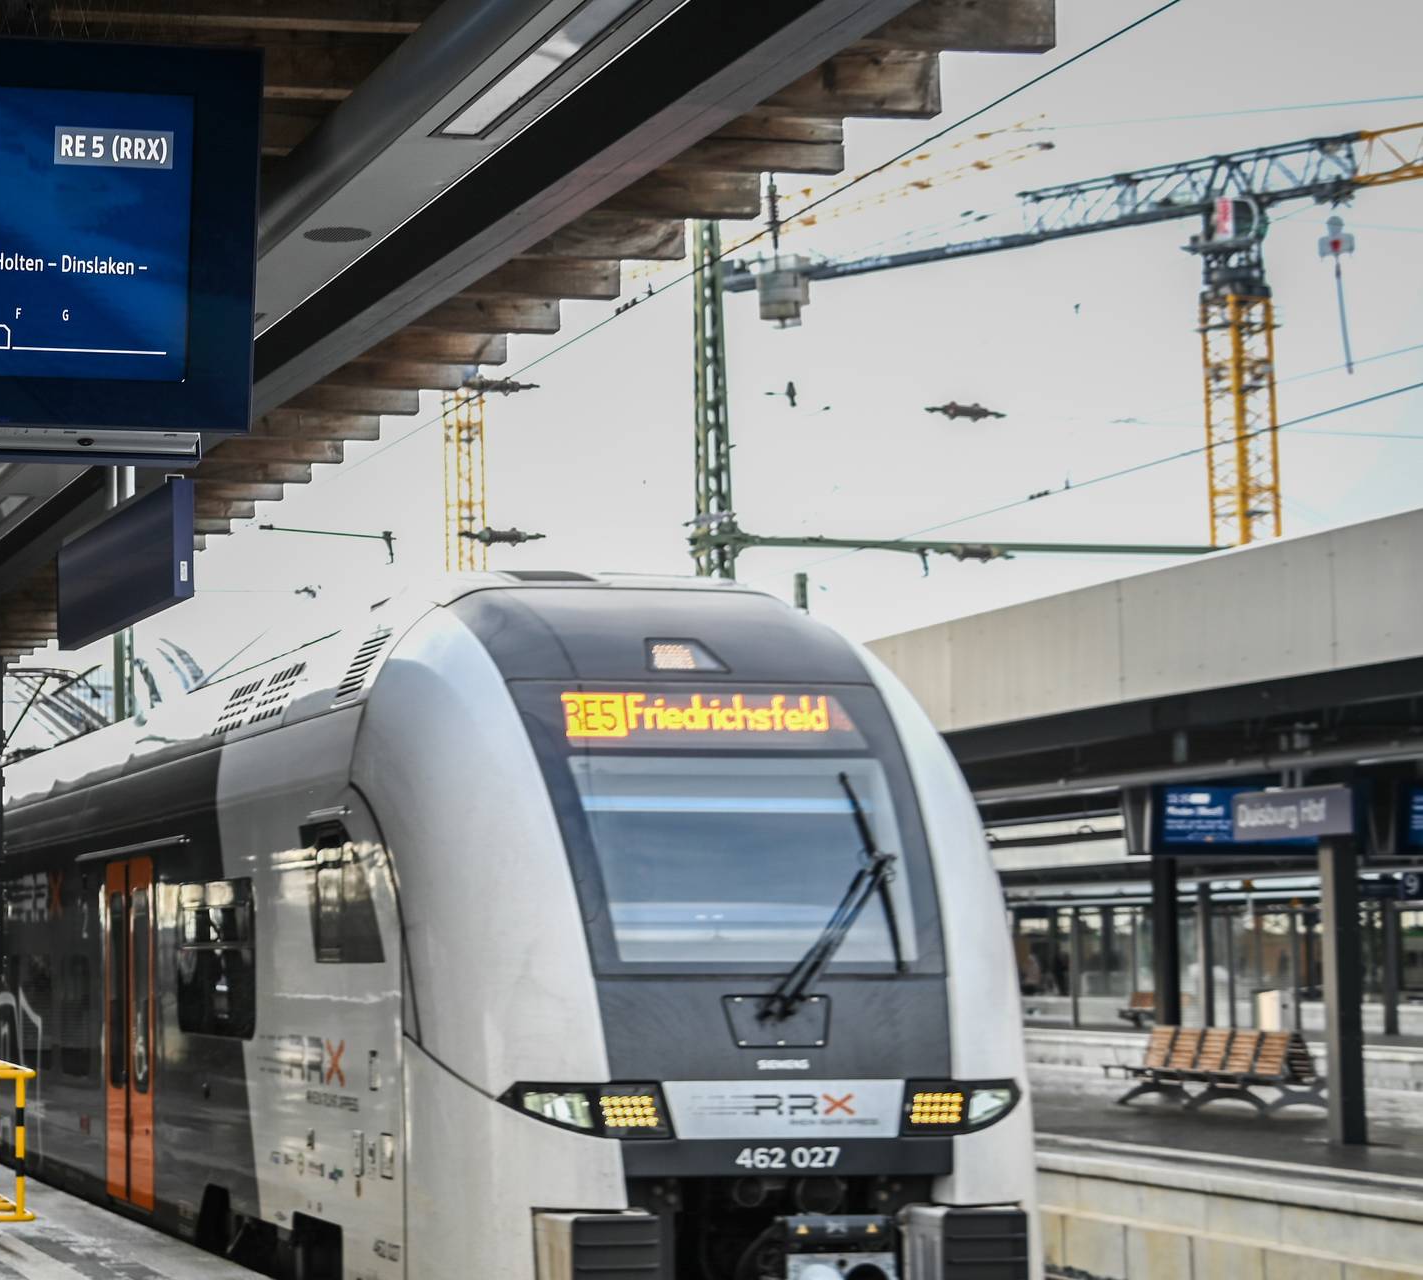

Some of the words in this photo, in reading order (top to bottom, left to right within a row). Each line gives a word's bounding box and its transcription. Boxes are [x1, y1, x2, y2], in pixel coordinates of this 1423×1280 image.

[60, 134, 87, 157] RE
[91, 135, 105, 158] 5
[112, 135, 168, 164] (RRX)
[61, 254, 135, 276] Dinslaken
[15, 307, 22, 320] F
[62, 309, 70, 322] G
[566, 700, 618, 731] RE5
[628, 694, 829, 731] Friedrichsfeld
[752, 1093, 855, 1116] RRX
[734, 1146, 787, 1169] 462
[790, 1146, 841, 1169] 027
